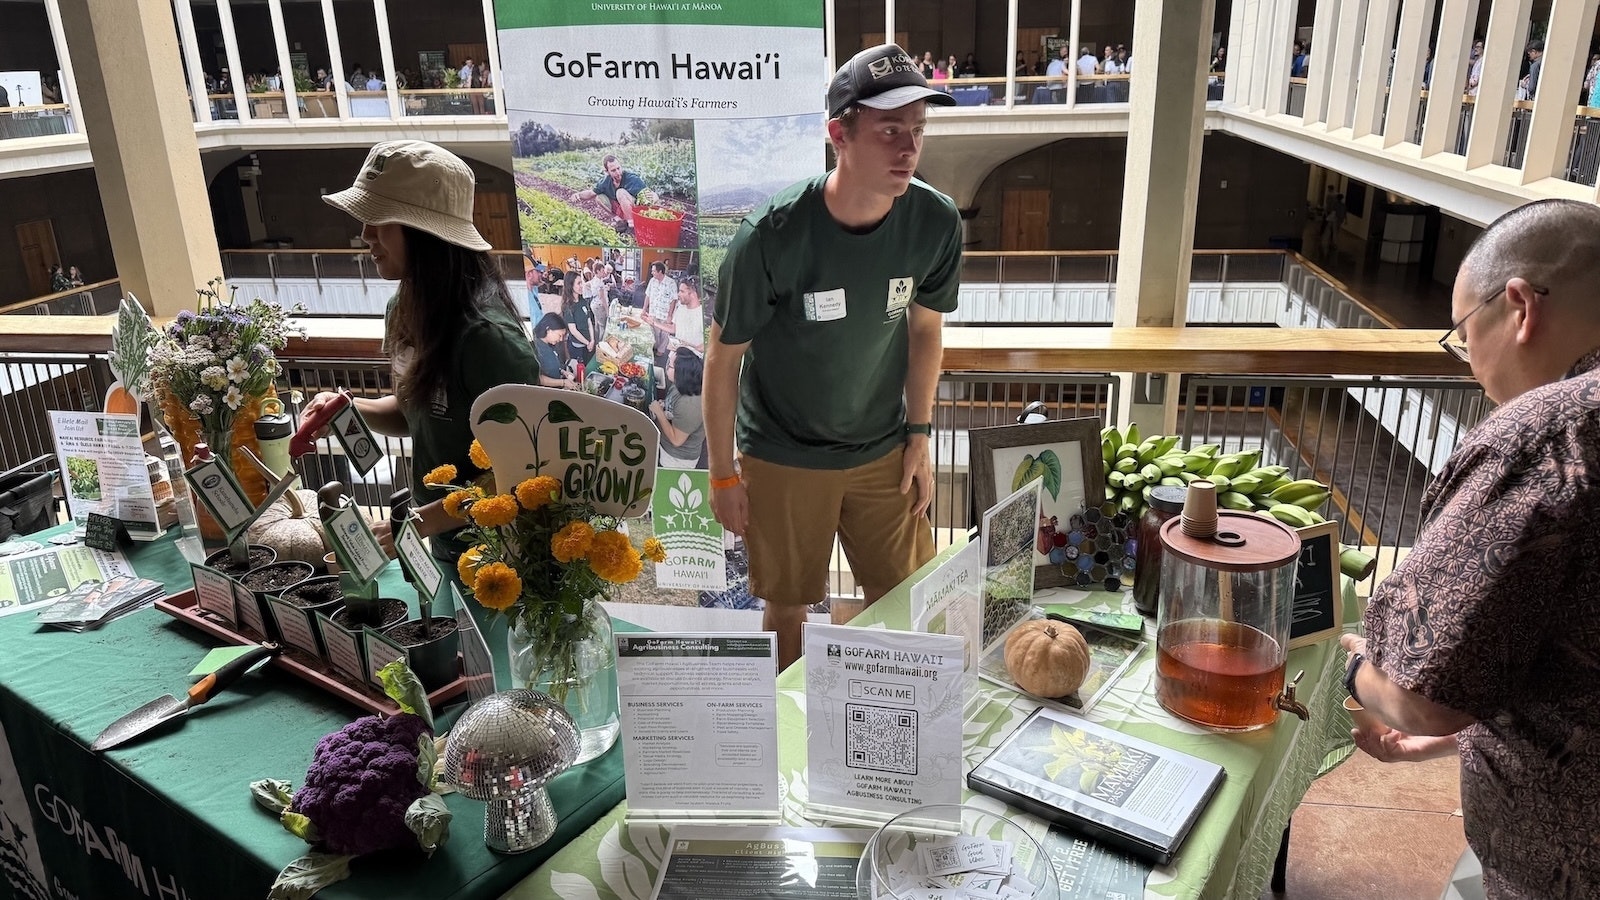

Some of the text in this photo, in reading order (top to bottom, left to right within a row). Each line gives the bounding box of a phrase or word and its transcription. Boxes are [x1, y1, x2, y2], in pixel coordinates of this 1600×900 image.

[591, 2, 635, 11] UNIVERSITY
[636, 2, 648, 11] OF
[680, 3, 690, 11] AT
[543, 51, 780, 80] GoFarm Hawai'i
[587, 96, 635, 110] Growing
[691, 98, 738, 109] Farmers
[559, 424, 647, 467] LET'S
[564, 463, 645, 509] GROW!
[664, 556, 716, 570] GOFARM
[673, 570, 709, 580] HAWAI'I
[956, 569, 969, 586] TEA
[680, 644, 720, 652] Consulting
[844, 646, 890, 660] GOFARM
[844, 661, 938, 681] www.gofarmhawaii.org
[864, 686, 912, 699] SCAN ME
[876, 776, 891, 784] MORE
[1108, 787, 1126, 804] PAST
[1126, 754, 1152, 782] PRESENT
[846, 790, 922, 805] AGBUSINESS CONSULTING
[34, 784, 150, 896] GOFARM
[1068, 839, 1089, 864] FREE
[1059, 870, 1078, 892] GET
